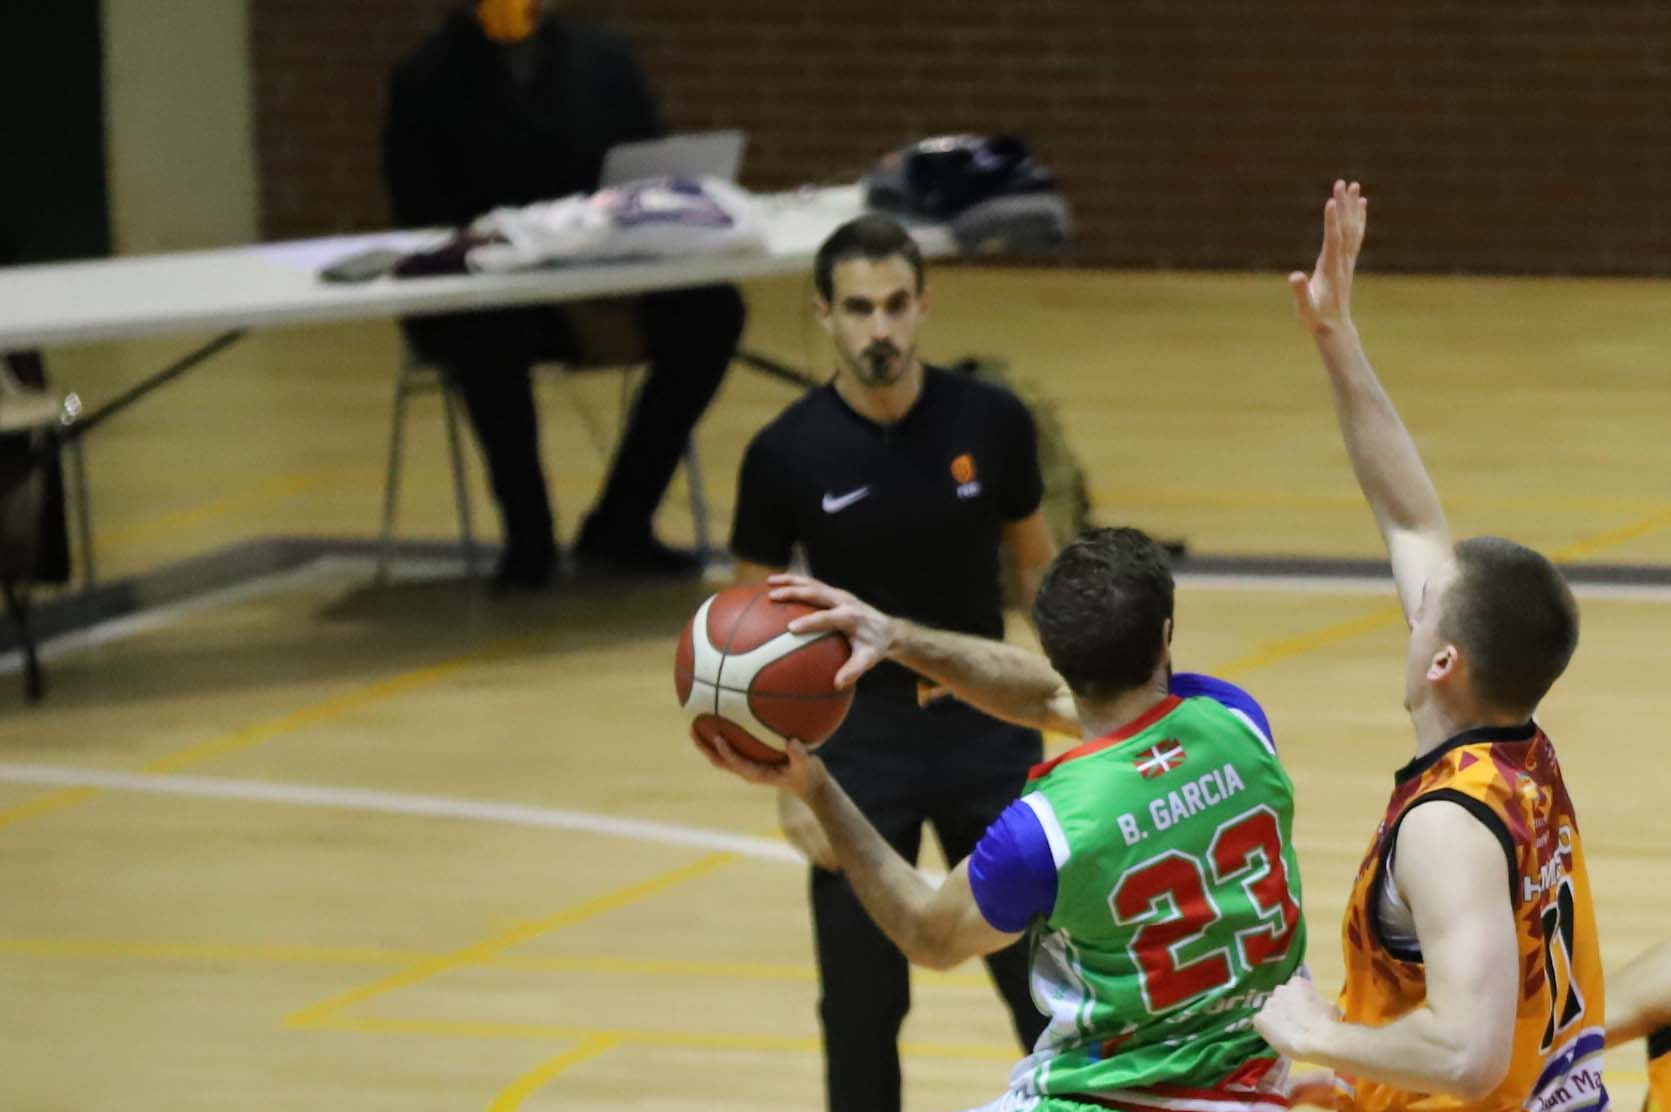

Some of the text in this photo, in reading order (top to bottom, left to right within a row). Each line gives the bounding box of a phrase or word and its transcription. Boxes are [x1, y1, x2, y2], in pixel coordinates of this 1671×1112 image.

[1117, 763, 1244, 846] B. GARCIA
[1107, 803, 1300, 1015] 23
